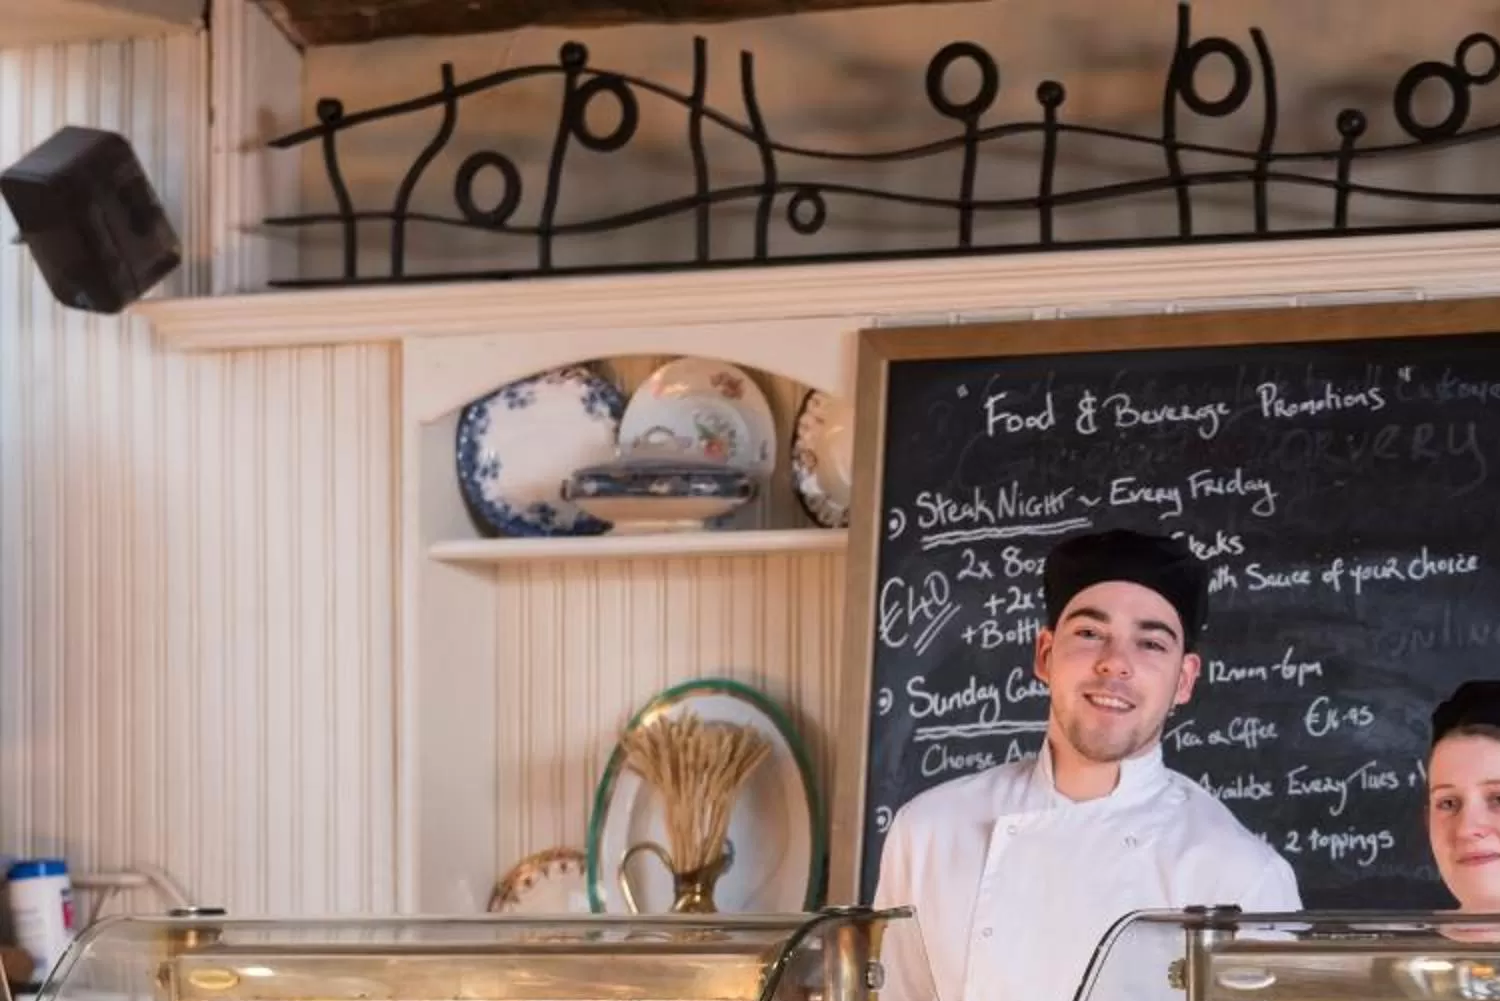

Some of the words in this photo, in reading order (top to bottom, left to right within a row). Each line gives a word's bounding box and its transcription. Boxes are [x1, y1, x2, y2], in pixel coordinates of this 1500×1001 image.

[916, 485, 996, 528] Steak
[1110, 476, 1183, 520] Every
[956, 548, 995, 581] 2x
[1171, 531, 1244, 560] teaks
[1245, 562, 1312, 591] Sauce
[1321, 556, 1345, 592] of
[1408, 545, 1480, 581] choice
[906, 675, 1001, 727] Sunday
[921, 745, 996, 776] Choose
[1287, 764, 1348, 817] Every
[1285, 829, 1302, 852] 2
[1309, 826, 1395, 868] toppings
